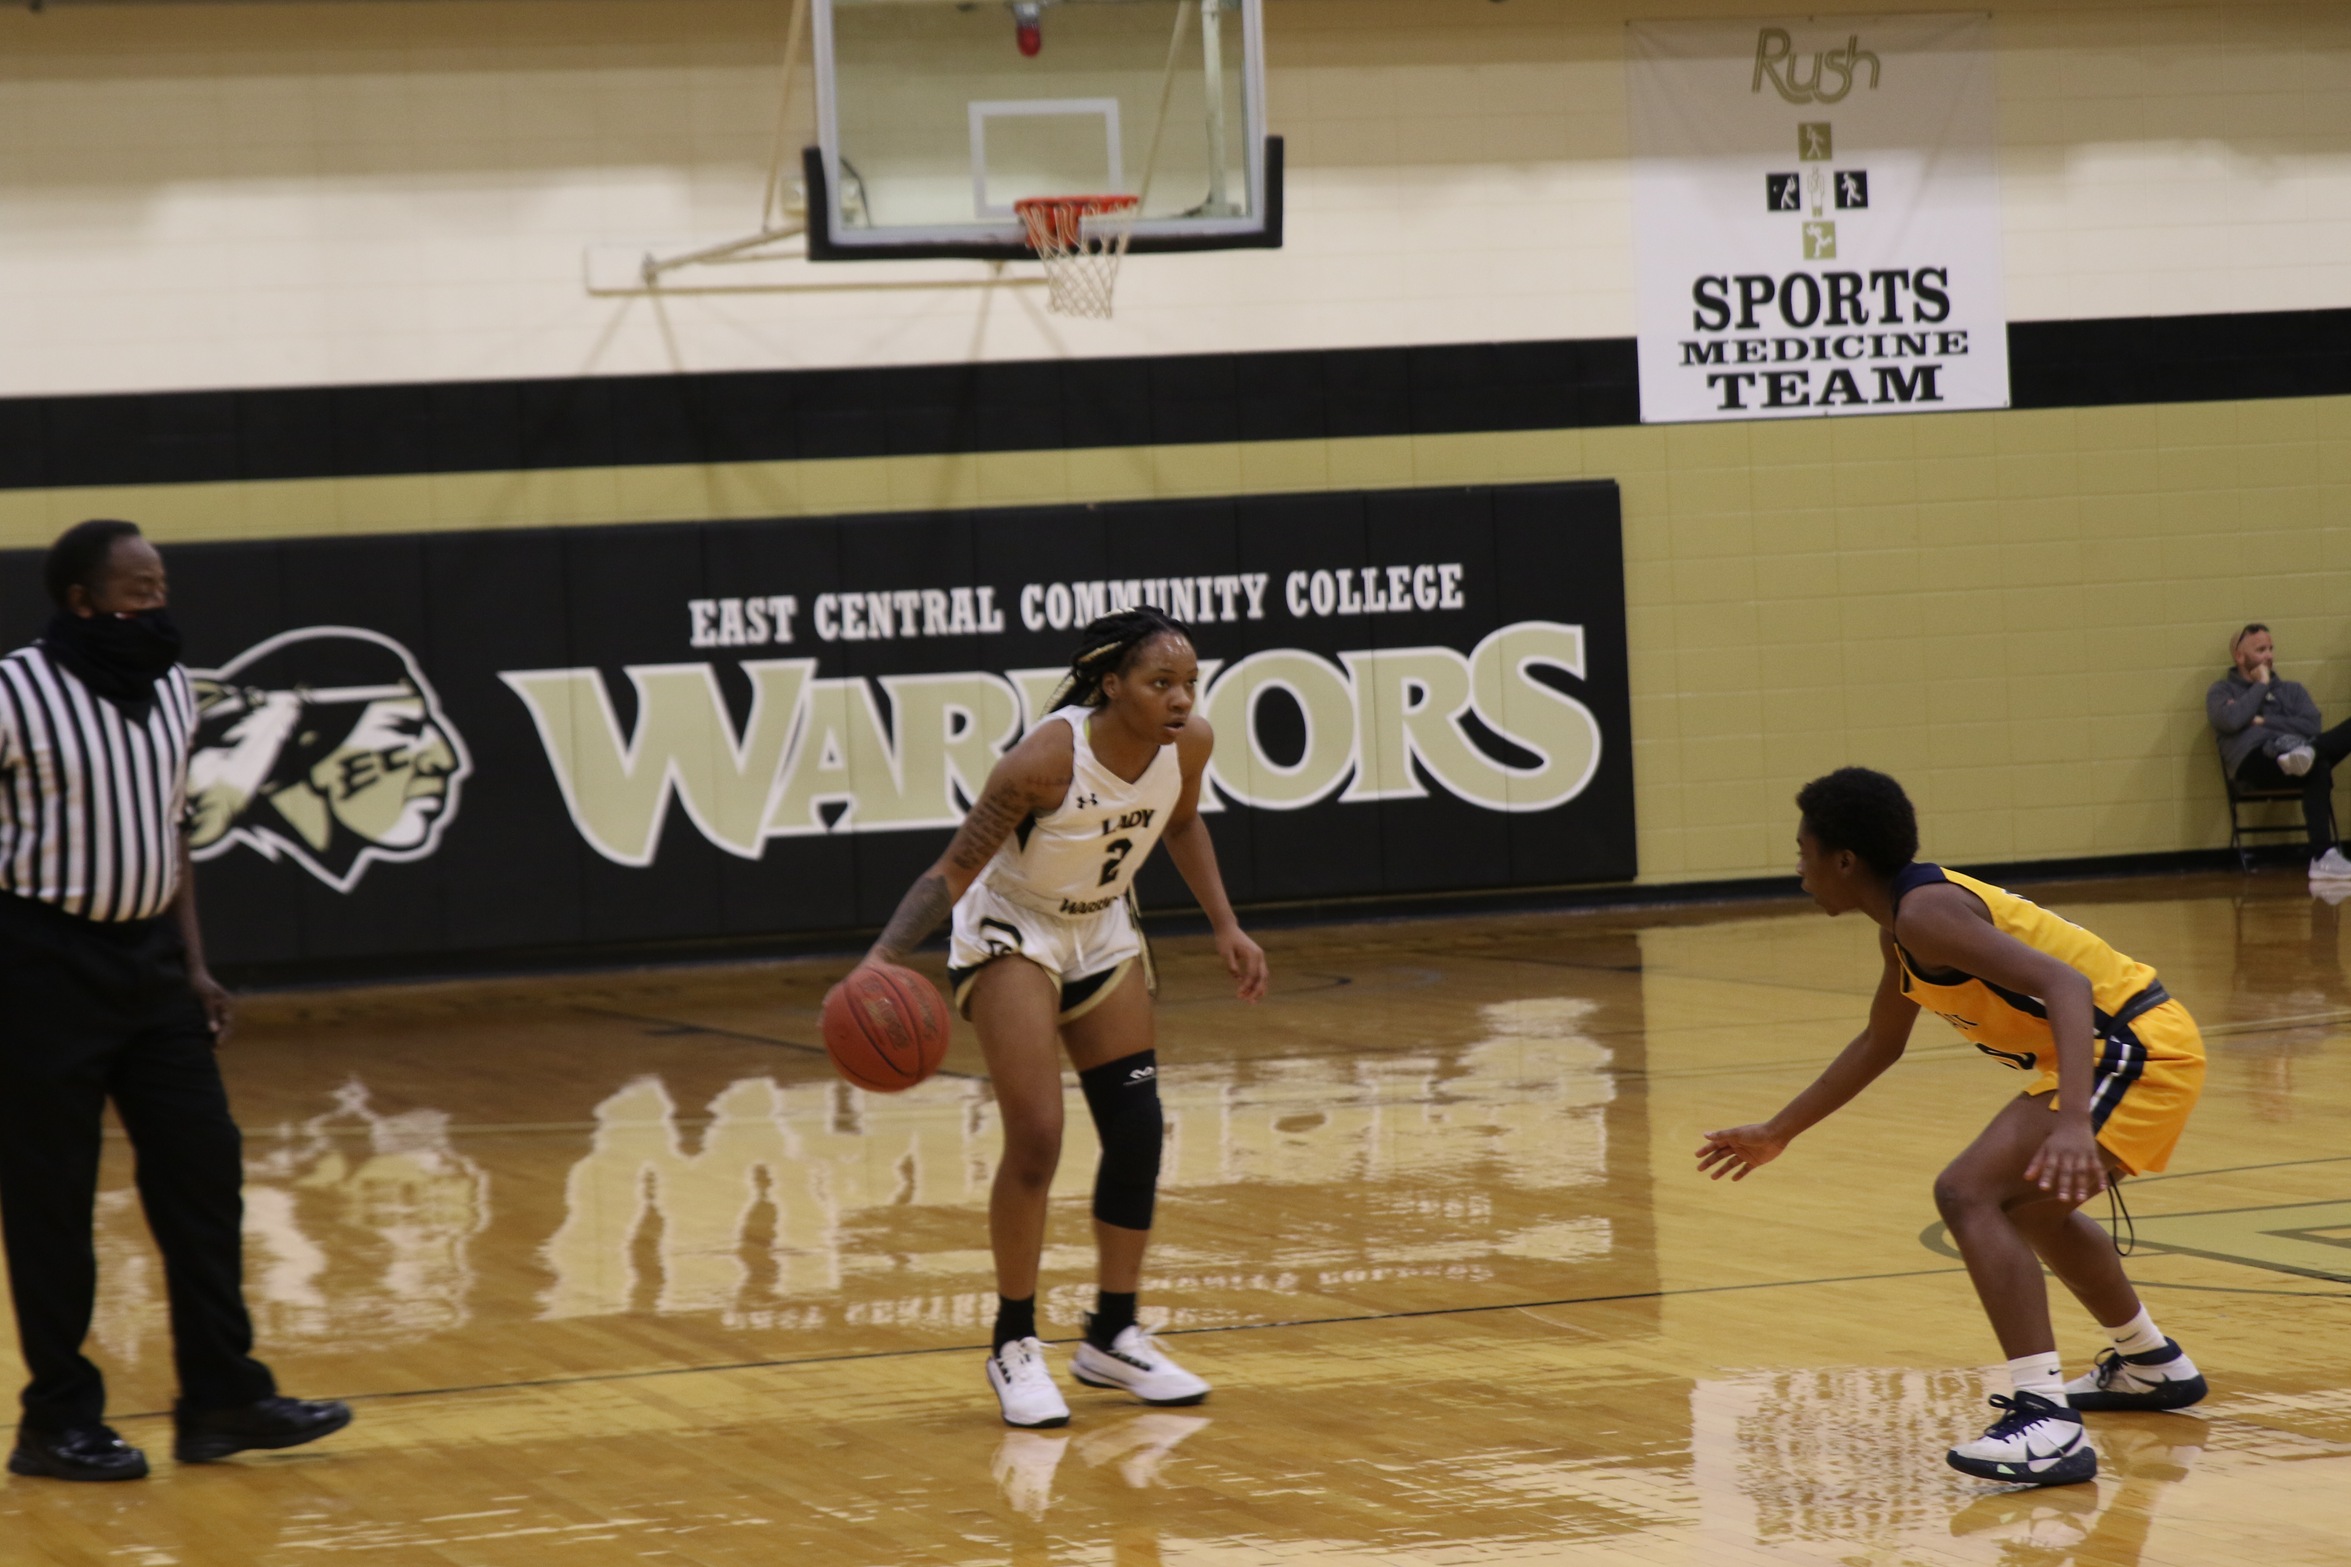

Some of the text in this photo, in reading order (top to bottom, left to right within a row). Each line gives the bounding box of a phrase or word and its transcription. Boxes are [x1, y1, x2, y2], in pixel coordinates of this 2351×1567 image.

[1751, 27, 1881, 104] Rush
[1692, 266, 1951, 332] SPORTS
[1678, 330, 1969, 367] MEDICINE
[1707, 364, 1944, 411] TEAM
[688, 562, 1465, 648] EAST CENTRAL COMMUNITY COLLEGE
[497, 620, 1602, 867] WARORS
[1102, 808, 1155, 836] LADY
[1098, 837, 1133, 887] 2
